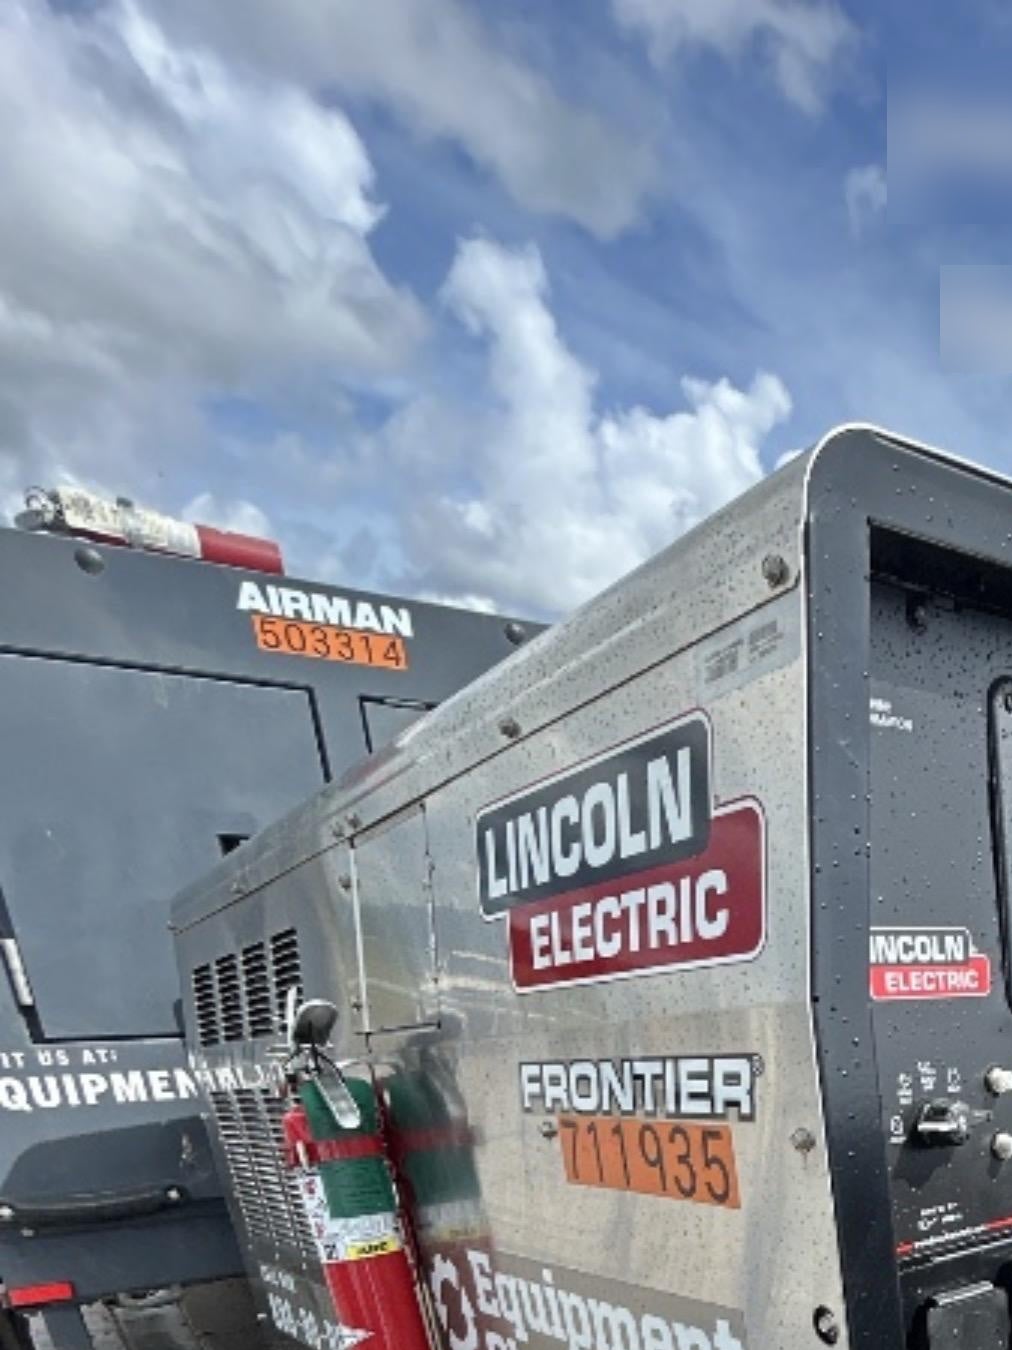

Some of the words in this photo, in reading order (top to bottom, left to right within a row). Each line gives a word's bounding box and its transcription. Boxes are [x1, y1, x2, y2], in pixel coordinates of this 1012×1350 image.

[236, 581, 414, 638] AIRMAN
[258, 619, 402, 668] 503314
[484, 746, 694, 899] LINCOLN
[529, 868, 729, 971] ELECTRIC
[869, 933, 965, 964] INCOLN
[884, 969, 979, 994] ELECTRIC
[38, 1049, 70, 1067] US
[560, 1120, 731, 1204] 711935
